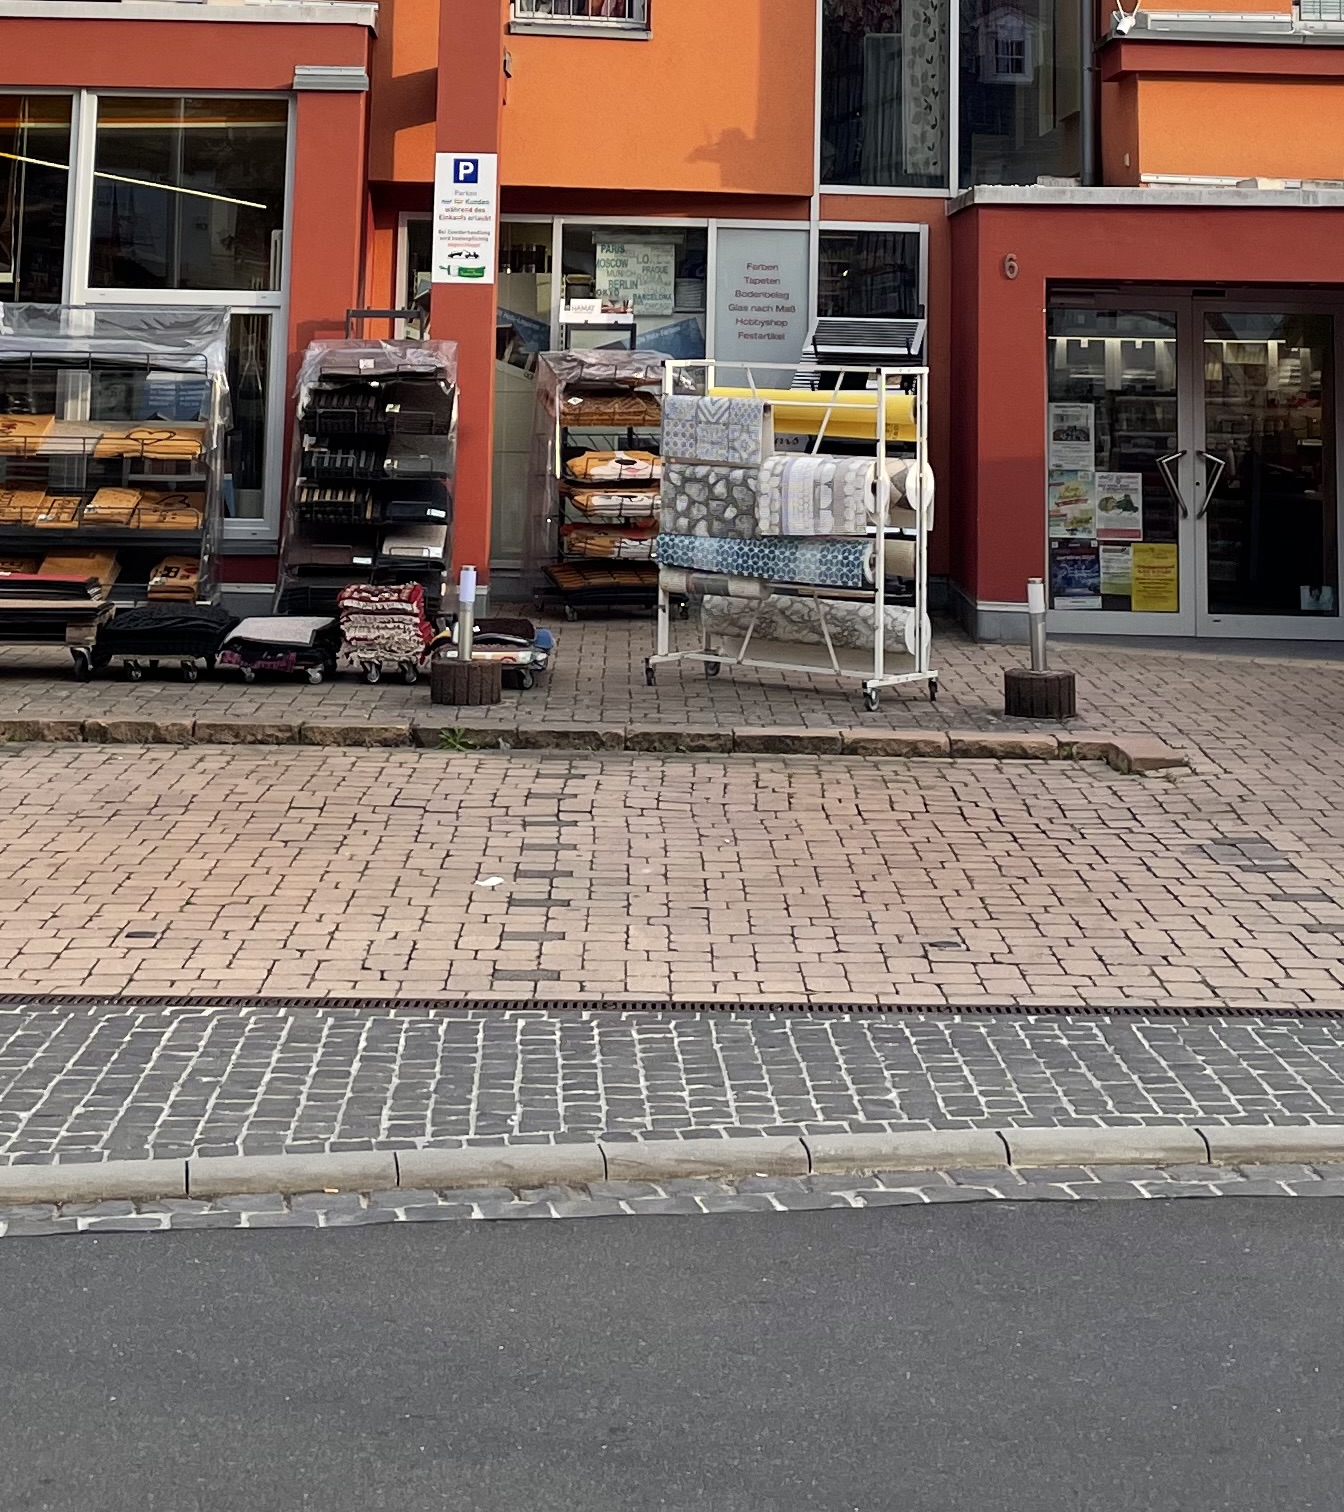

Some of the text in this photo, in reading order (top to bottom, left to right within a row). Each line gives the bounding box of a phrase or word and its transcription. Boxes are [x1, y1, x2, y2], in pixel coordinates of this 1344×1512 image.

[458, 161, 474, 181] P
[600, 244, 625, 254] PARIS
[746, 262, 779, 271] Farben
[1005, 253, 1018, 279] 6
[608, 280, 638, 289] BERLIN
[744, 276, 780, 285] Tapeten
[596, 289, 619, 297] OKYO
[735, 290, 790, 300] Bodenbelag
[728, 304, 748, 312] Glas
[751, 304, 773, 313] nach
[736, 318, 788, 328] Hobbyshop
[738, 331, 785, 340] Festartikel
